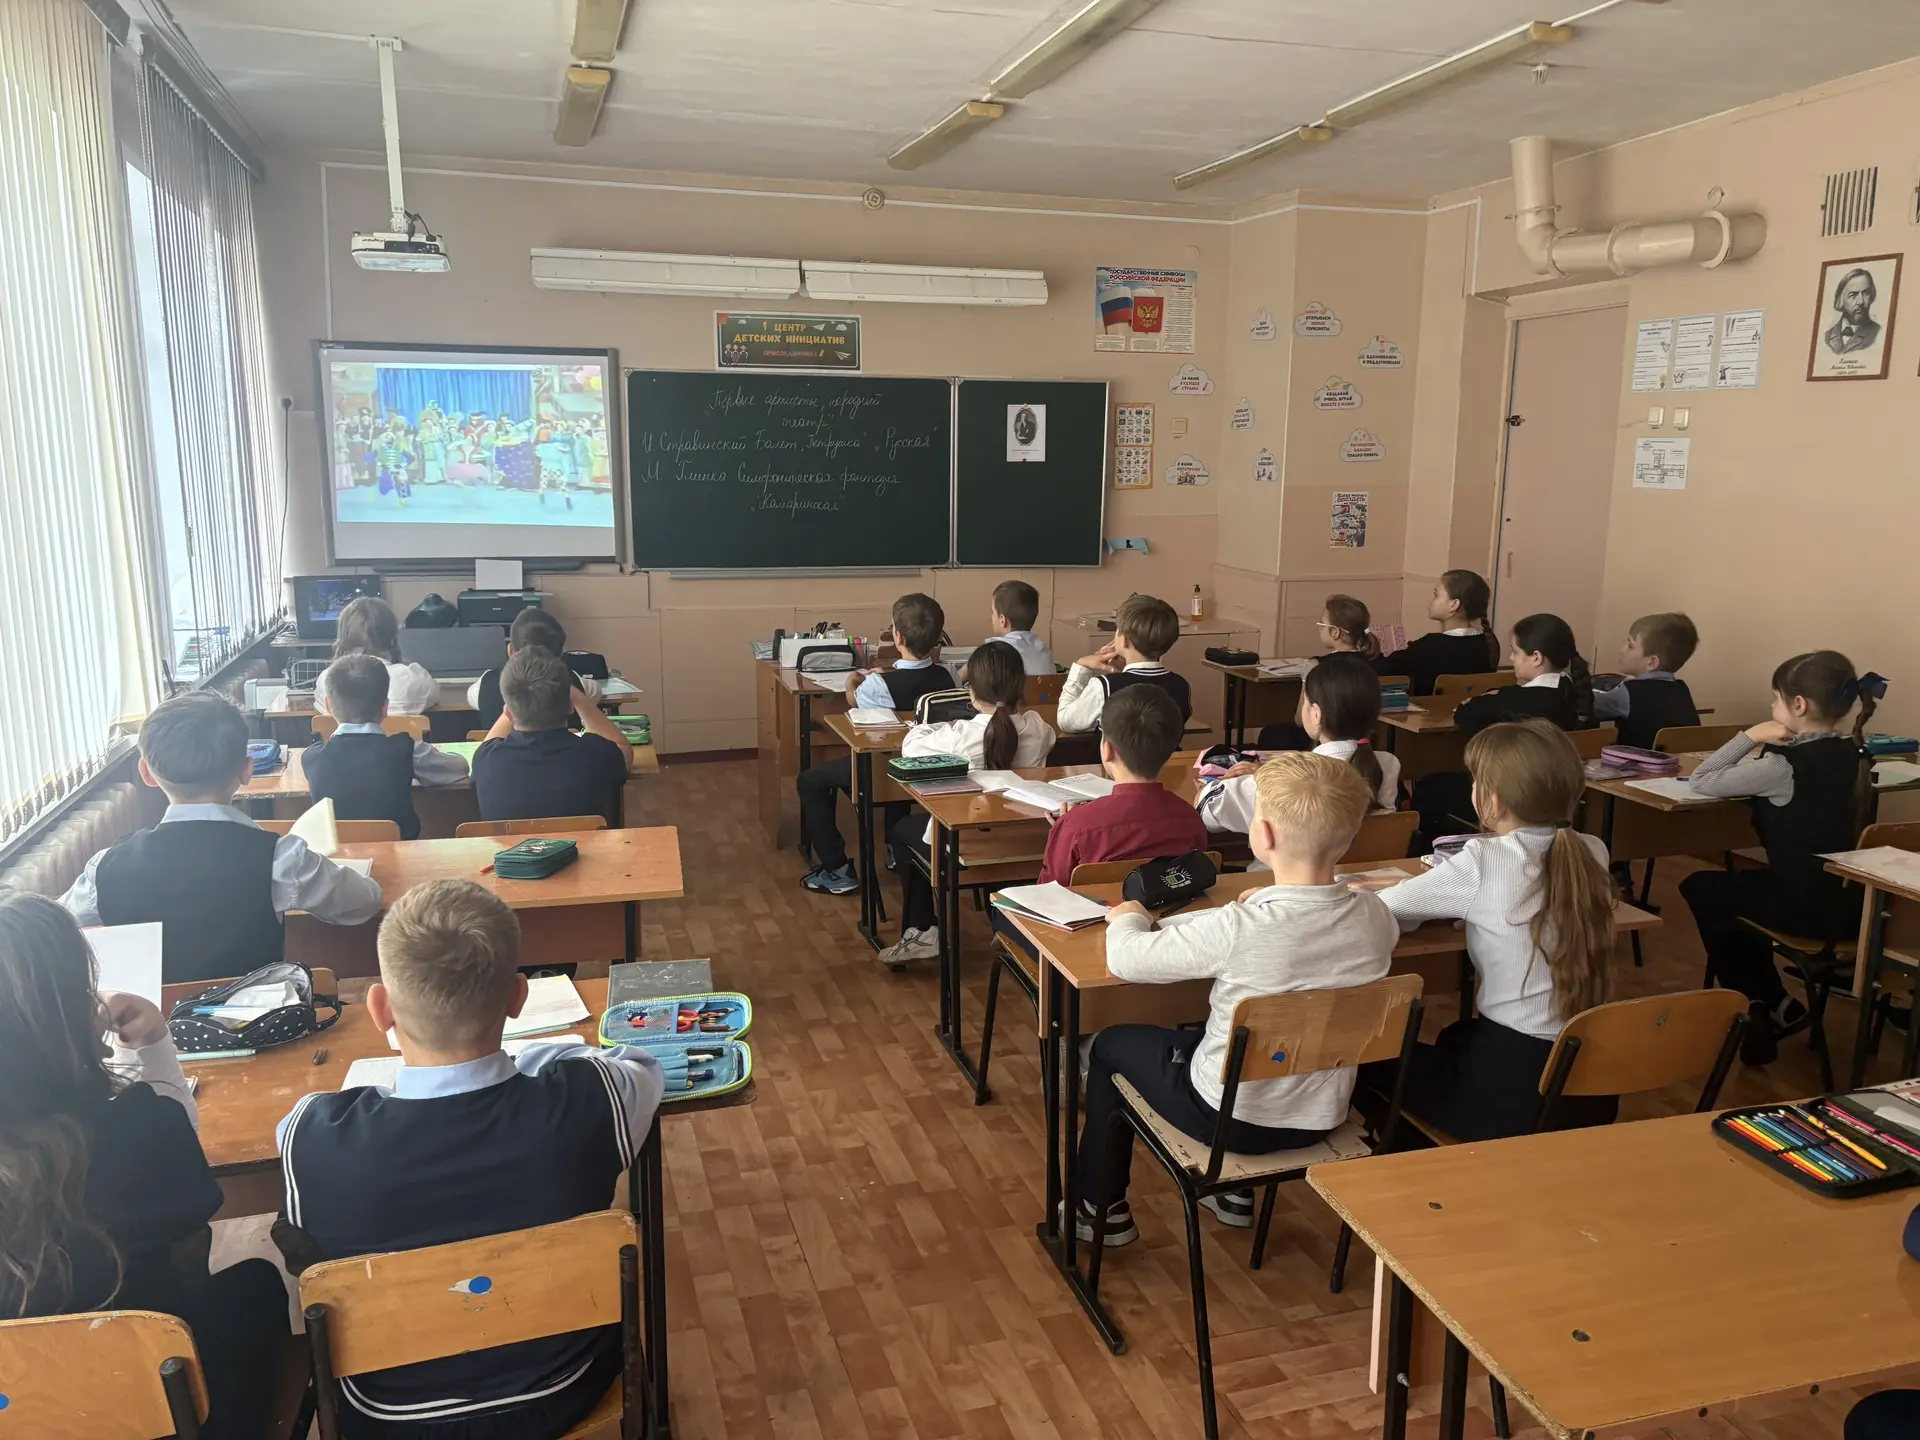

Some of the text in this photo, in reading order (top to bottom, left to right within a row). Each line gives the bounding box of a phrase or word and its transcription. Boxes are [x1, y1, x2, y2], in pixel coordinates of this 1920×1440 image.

[1109, 274, 1151, 282] РОССИЙСКОЙ
[774, 323, 807, 332] ЦЕНТР
[733, 333, 846, 345] ДЕТСКИХ ИНИЦИАТИВ
[660, 428, 747, 464] Стравинский
[756, 429, 797, 452] Балет
[675, 459, 728, 482] Глинка
[840, 465, 903, 497] фантазия
